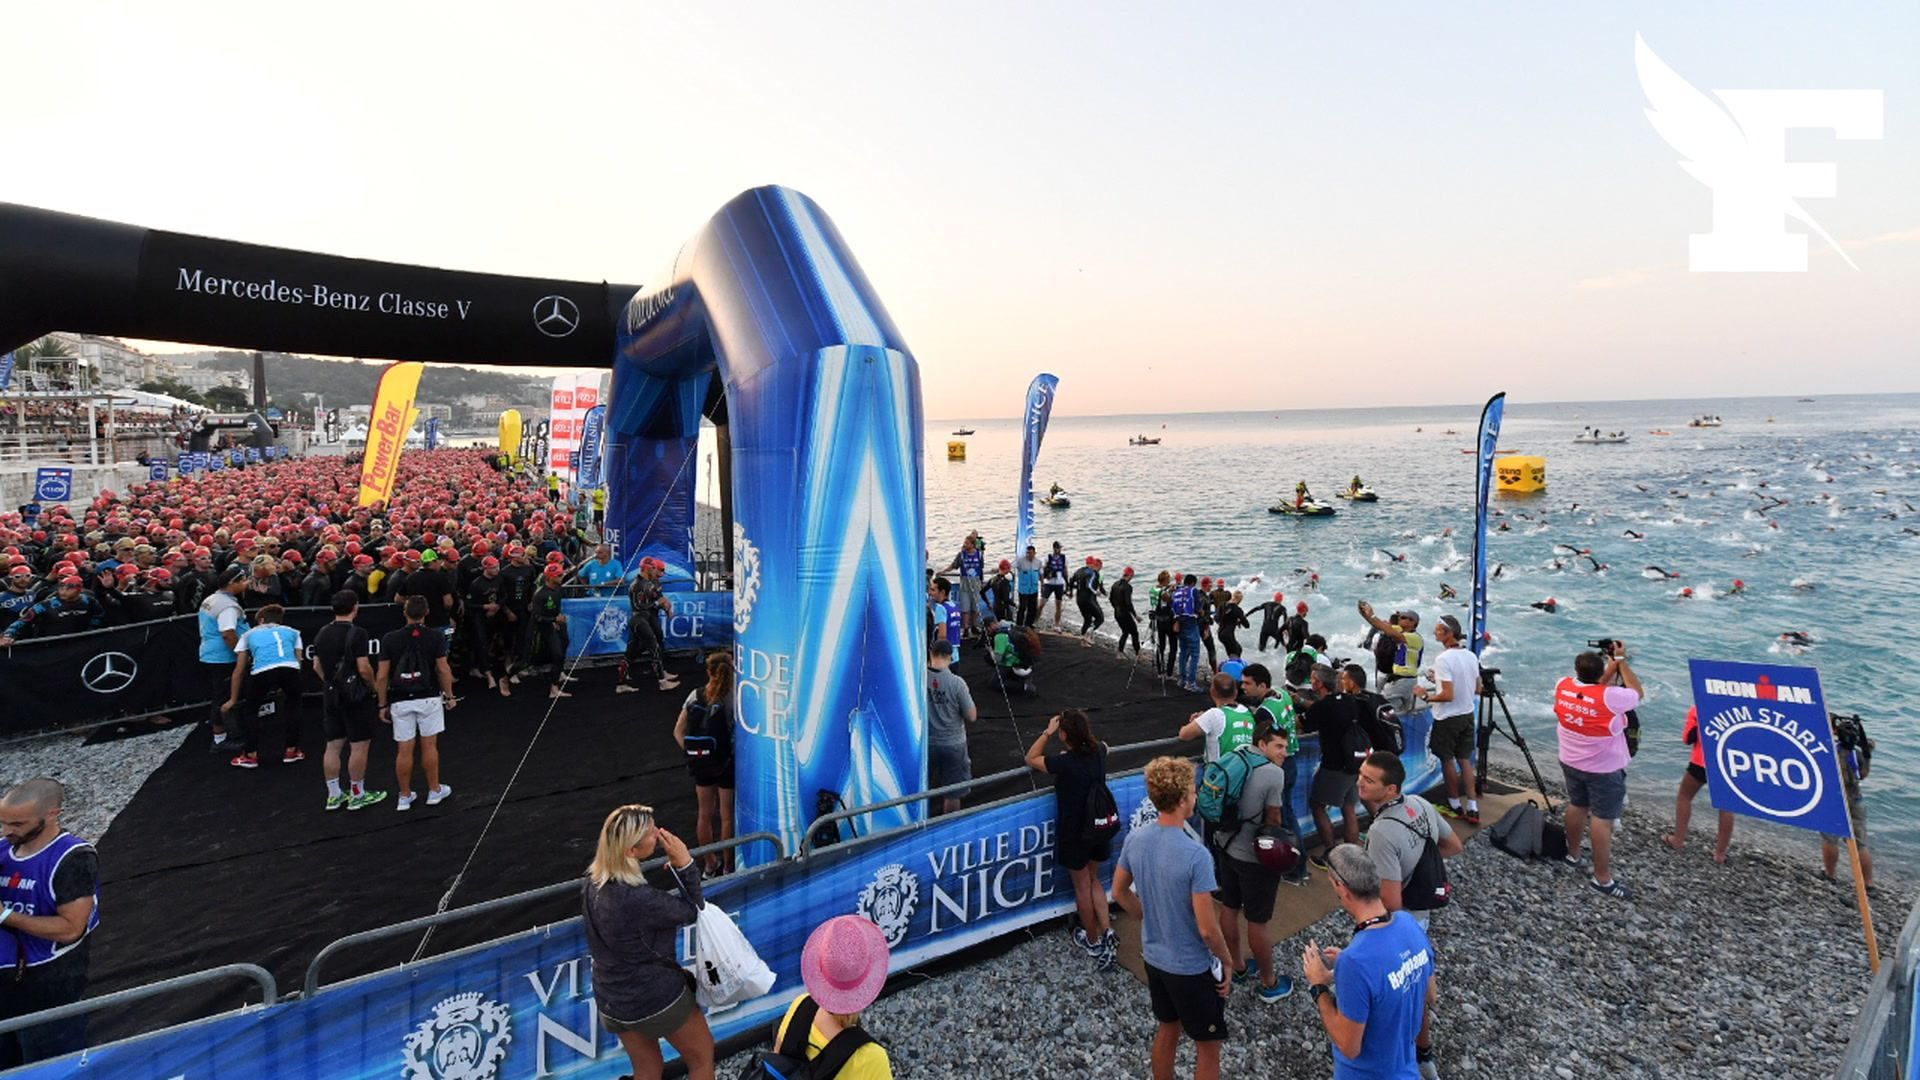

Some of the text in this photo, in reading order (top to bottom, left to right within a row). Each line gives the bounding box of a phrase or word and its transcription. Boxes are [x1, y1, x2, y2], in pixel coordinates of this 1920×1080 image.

[176, 267, 472, 320] Mercedes-Benz Classe V
[361, 401, 401, 492] PowerBar
[660, 615, 704, 638] ICE
[683, 601, 706, 615] DE
[750, 648, 790, 686] DE
[1705, 675, 1813, 704] IRONMAN
[1564, 713, 1584, 727] 24
[1705, 706, 1829, 755] SWIM START
[1727, 749, 1811, 791] PRO
[926, 819, 1056, 879] VILLE DE
[927, 850, 1056, 935] NICE
